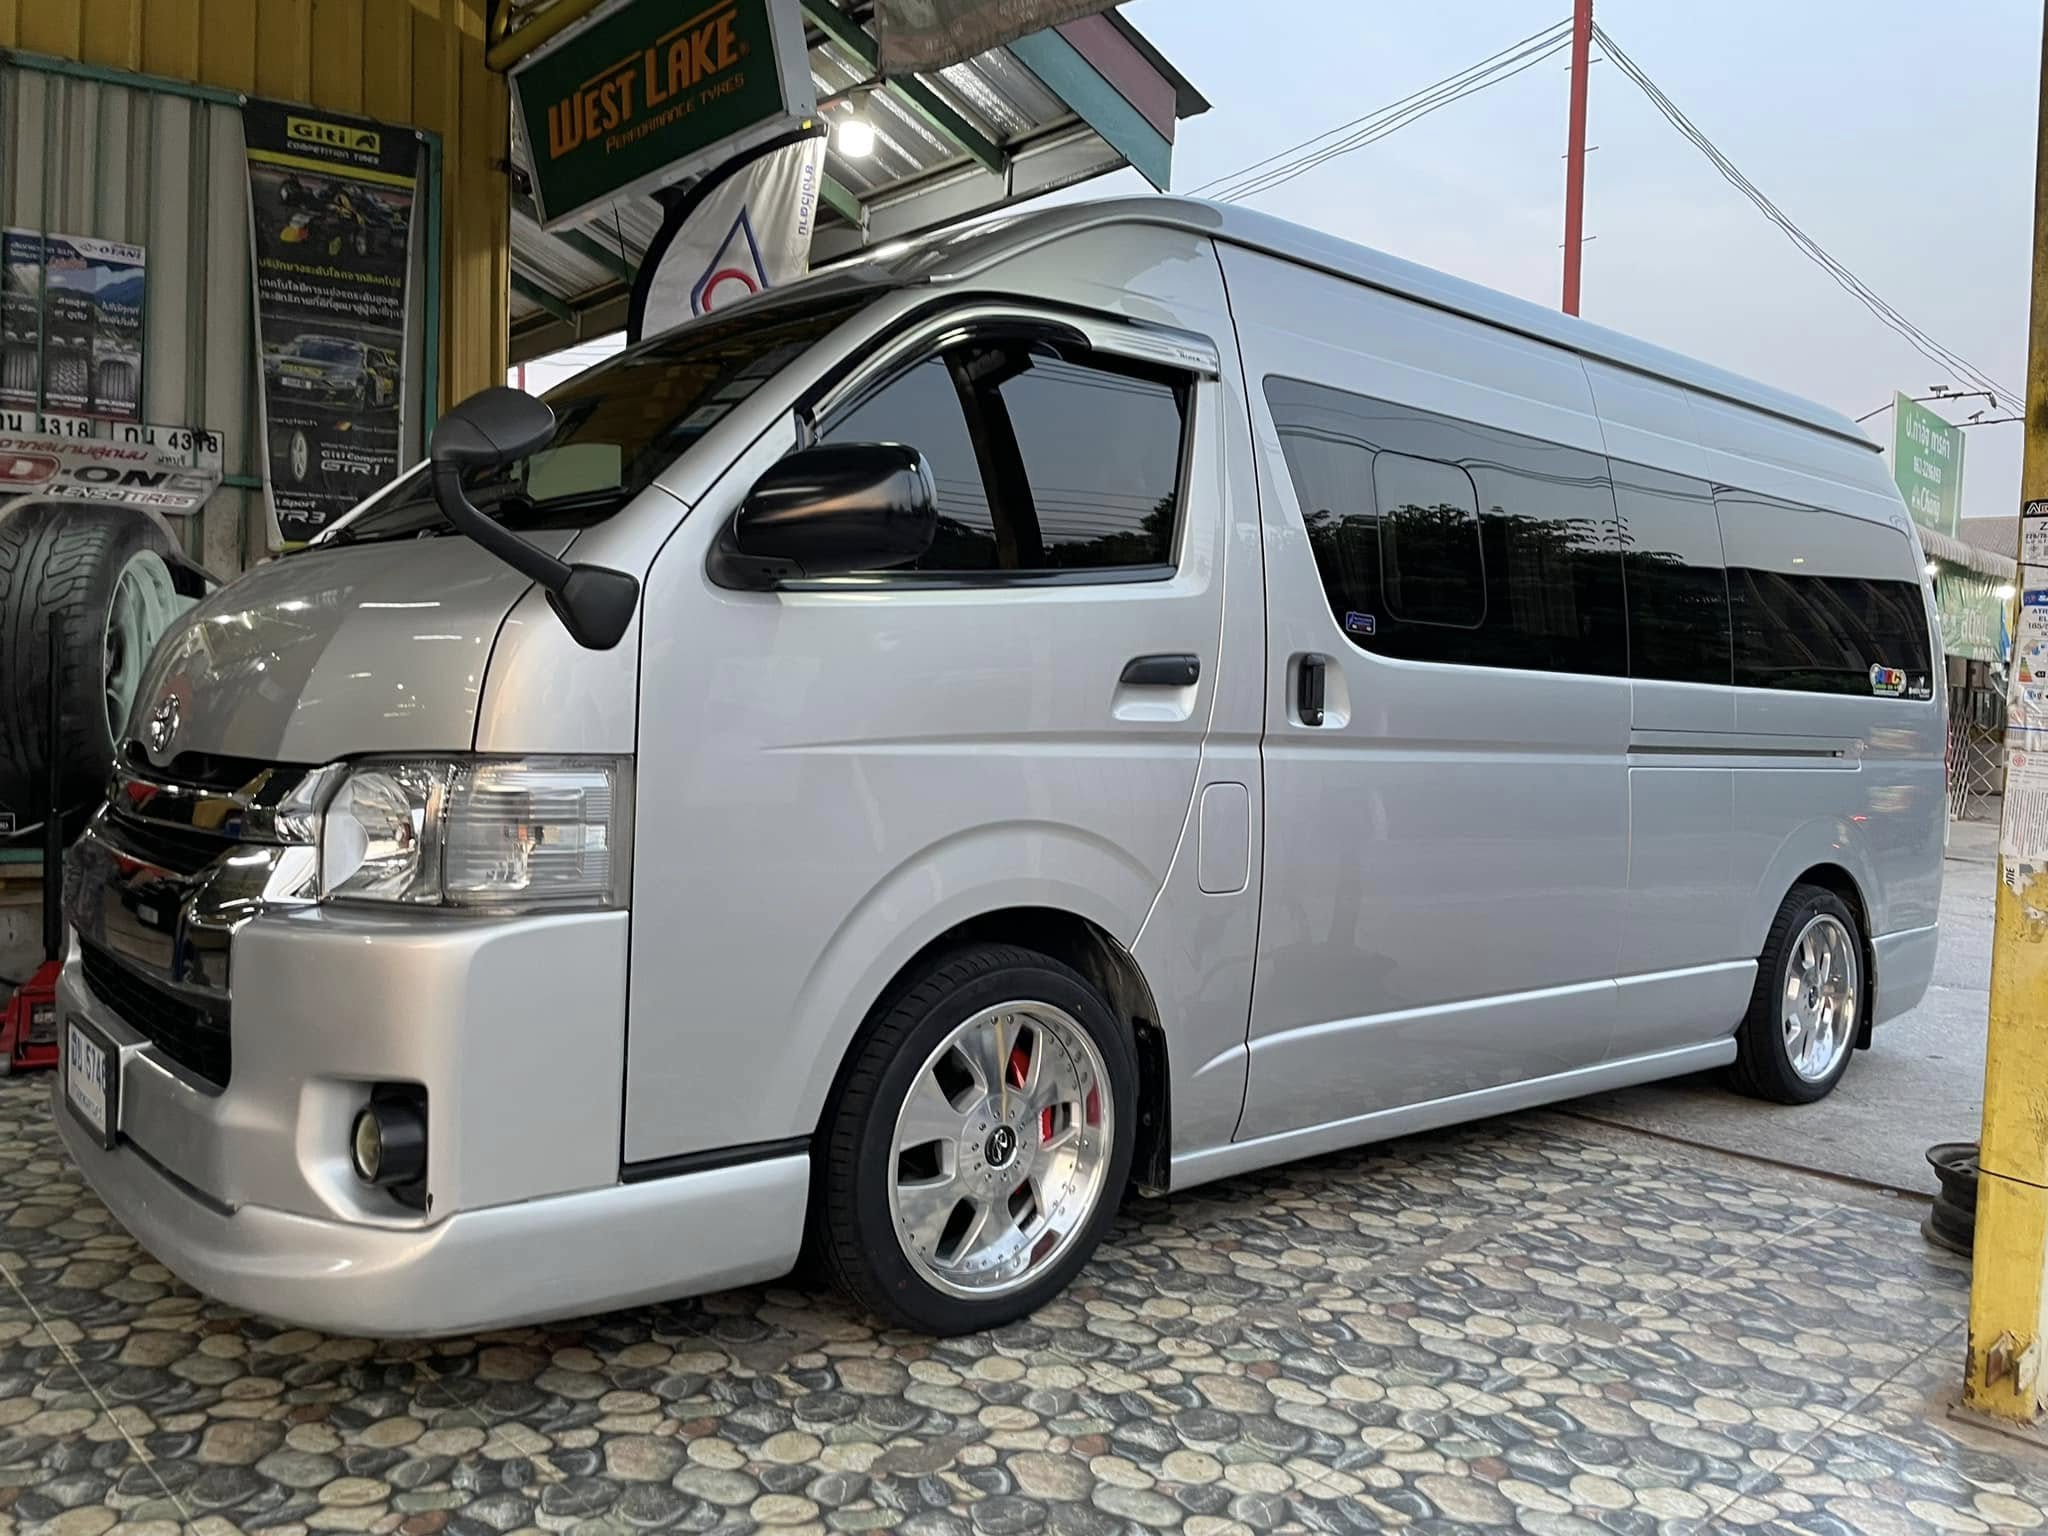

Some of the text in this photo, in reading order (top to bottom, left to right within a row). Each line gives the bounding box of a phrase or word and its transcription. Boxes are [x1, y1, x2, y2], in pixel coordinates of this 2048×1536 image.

[548, 9, 740, 160] WEST LAKE
[293, 122, 346, 145] Giti
[99, 246, 141, 260] OTANI
[275, 508, 326, 525] TR3
